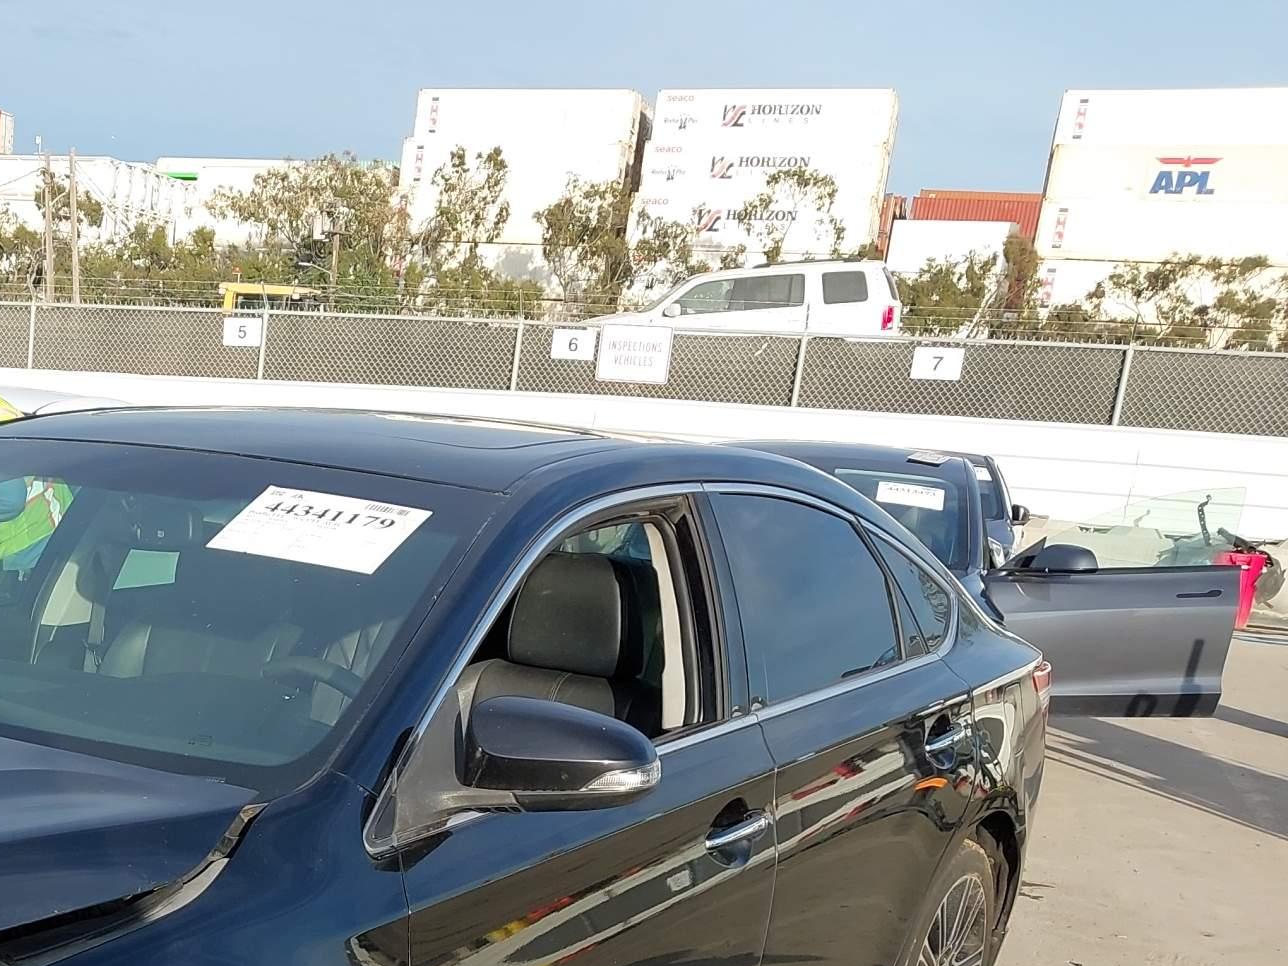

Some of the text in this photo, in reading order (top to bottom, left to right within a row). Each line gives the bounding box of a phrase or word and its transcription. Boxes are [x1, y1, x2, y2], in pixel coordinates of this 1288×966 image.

[666, 94, 695, 102] seaco
[751, 104, 823, 116] HORIZON
[738, 156, 811, 168] HORIZON
[1148, 170, 1216, 195] APL
[640, 198, 669, 206] seaco
[725, 209, 799, 222] HORIZON
[237, 325, 248, 340] 5
[567, 336, 579, 352] 6
[608, 340, 664, 353] INSPECTIONS
[613, 355, 654, 367] VEHICLES
[932, 356, 945, 371] 7
[264, 500, 396, 530] 44341179
